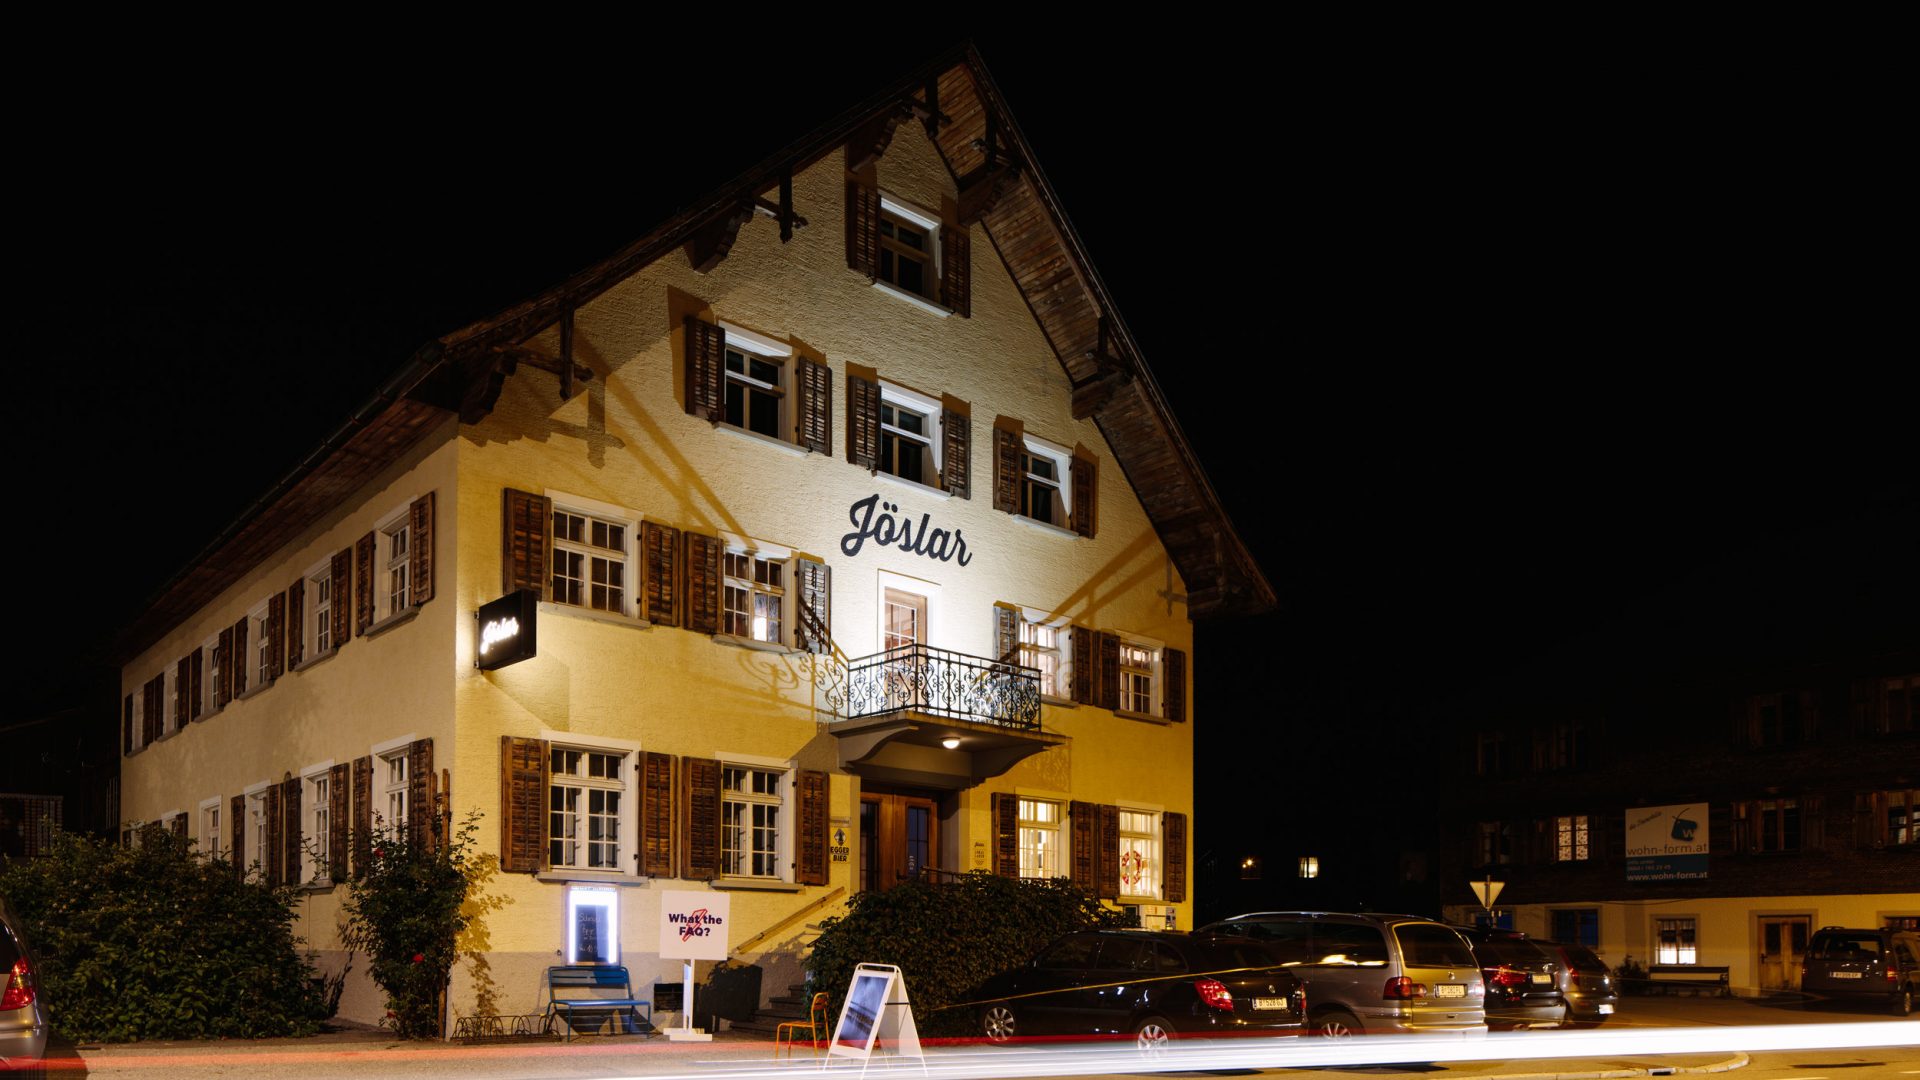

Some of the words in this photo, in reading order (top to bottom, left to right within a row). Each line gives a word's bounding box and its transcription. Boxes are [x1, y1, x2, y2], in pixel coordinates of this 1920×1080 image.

[841, 493, 973, 567] Jöslar
[830, 846, 849, 856] EGGER
[1627, 843, 1708, 856] wohn-form.at
[833, 854, 847, 862] BIER
[1627, 871, 1708, 881] www.wohn-form.at
[668, 913, 700, 924] What
[703, 914, 723, 925] the
[679, 926, 711, 937] FAQ?
